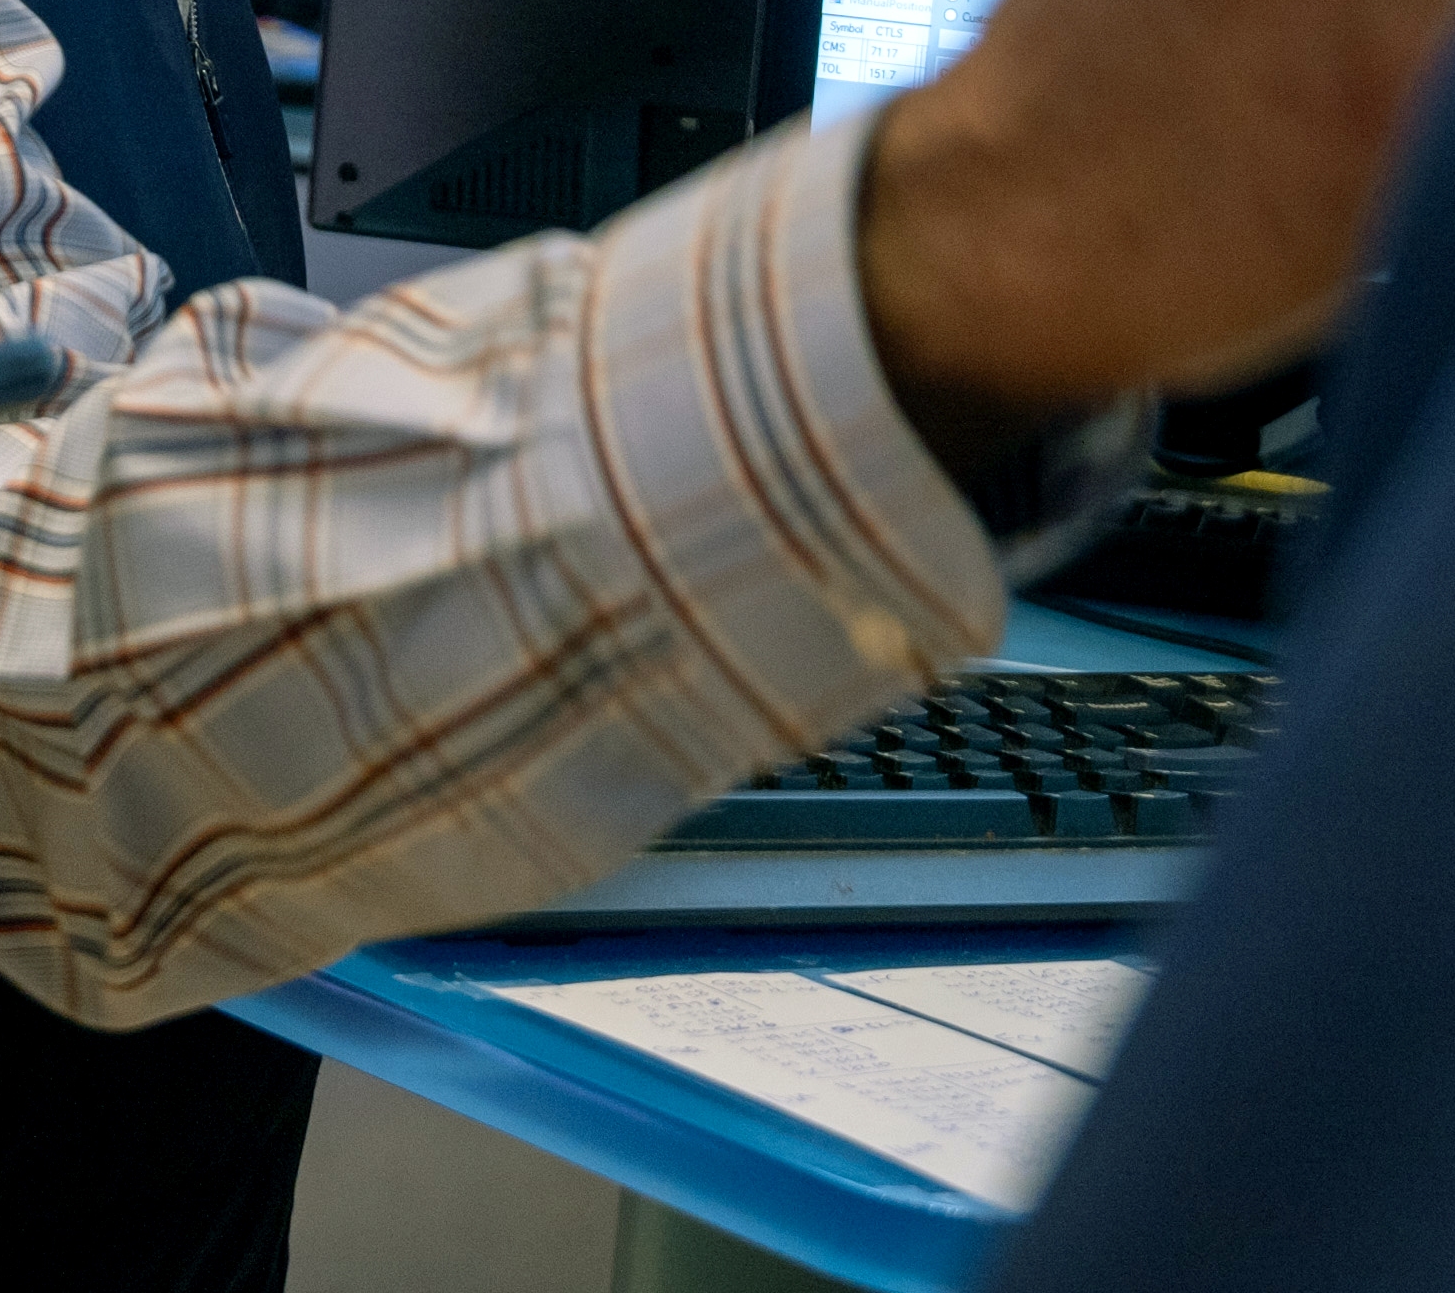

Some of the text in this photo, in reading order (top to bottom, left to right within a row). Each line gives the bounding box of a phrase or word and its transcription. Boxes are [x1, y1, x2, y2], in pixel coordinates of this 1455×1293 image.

[829, 21, 904, 38] Symbol CTLS
[822, 40, 846, 53] CMS
[821, 62, 897, 79] TOL 151.7
